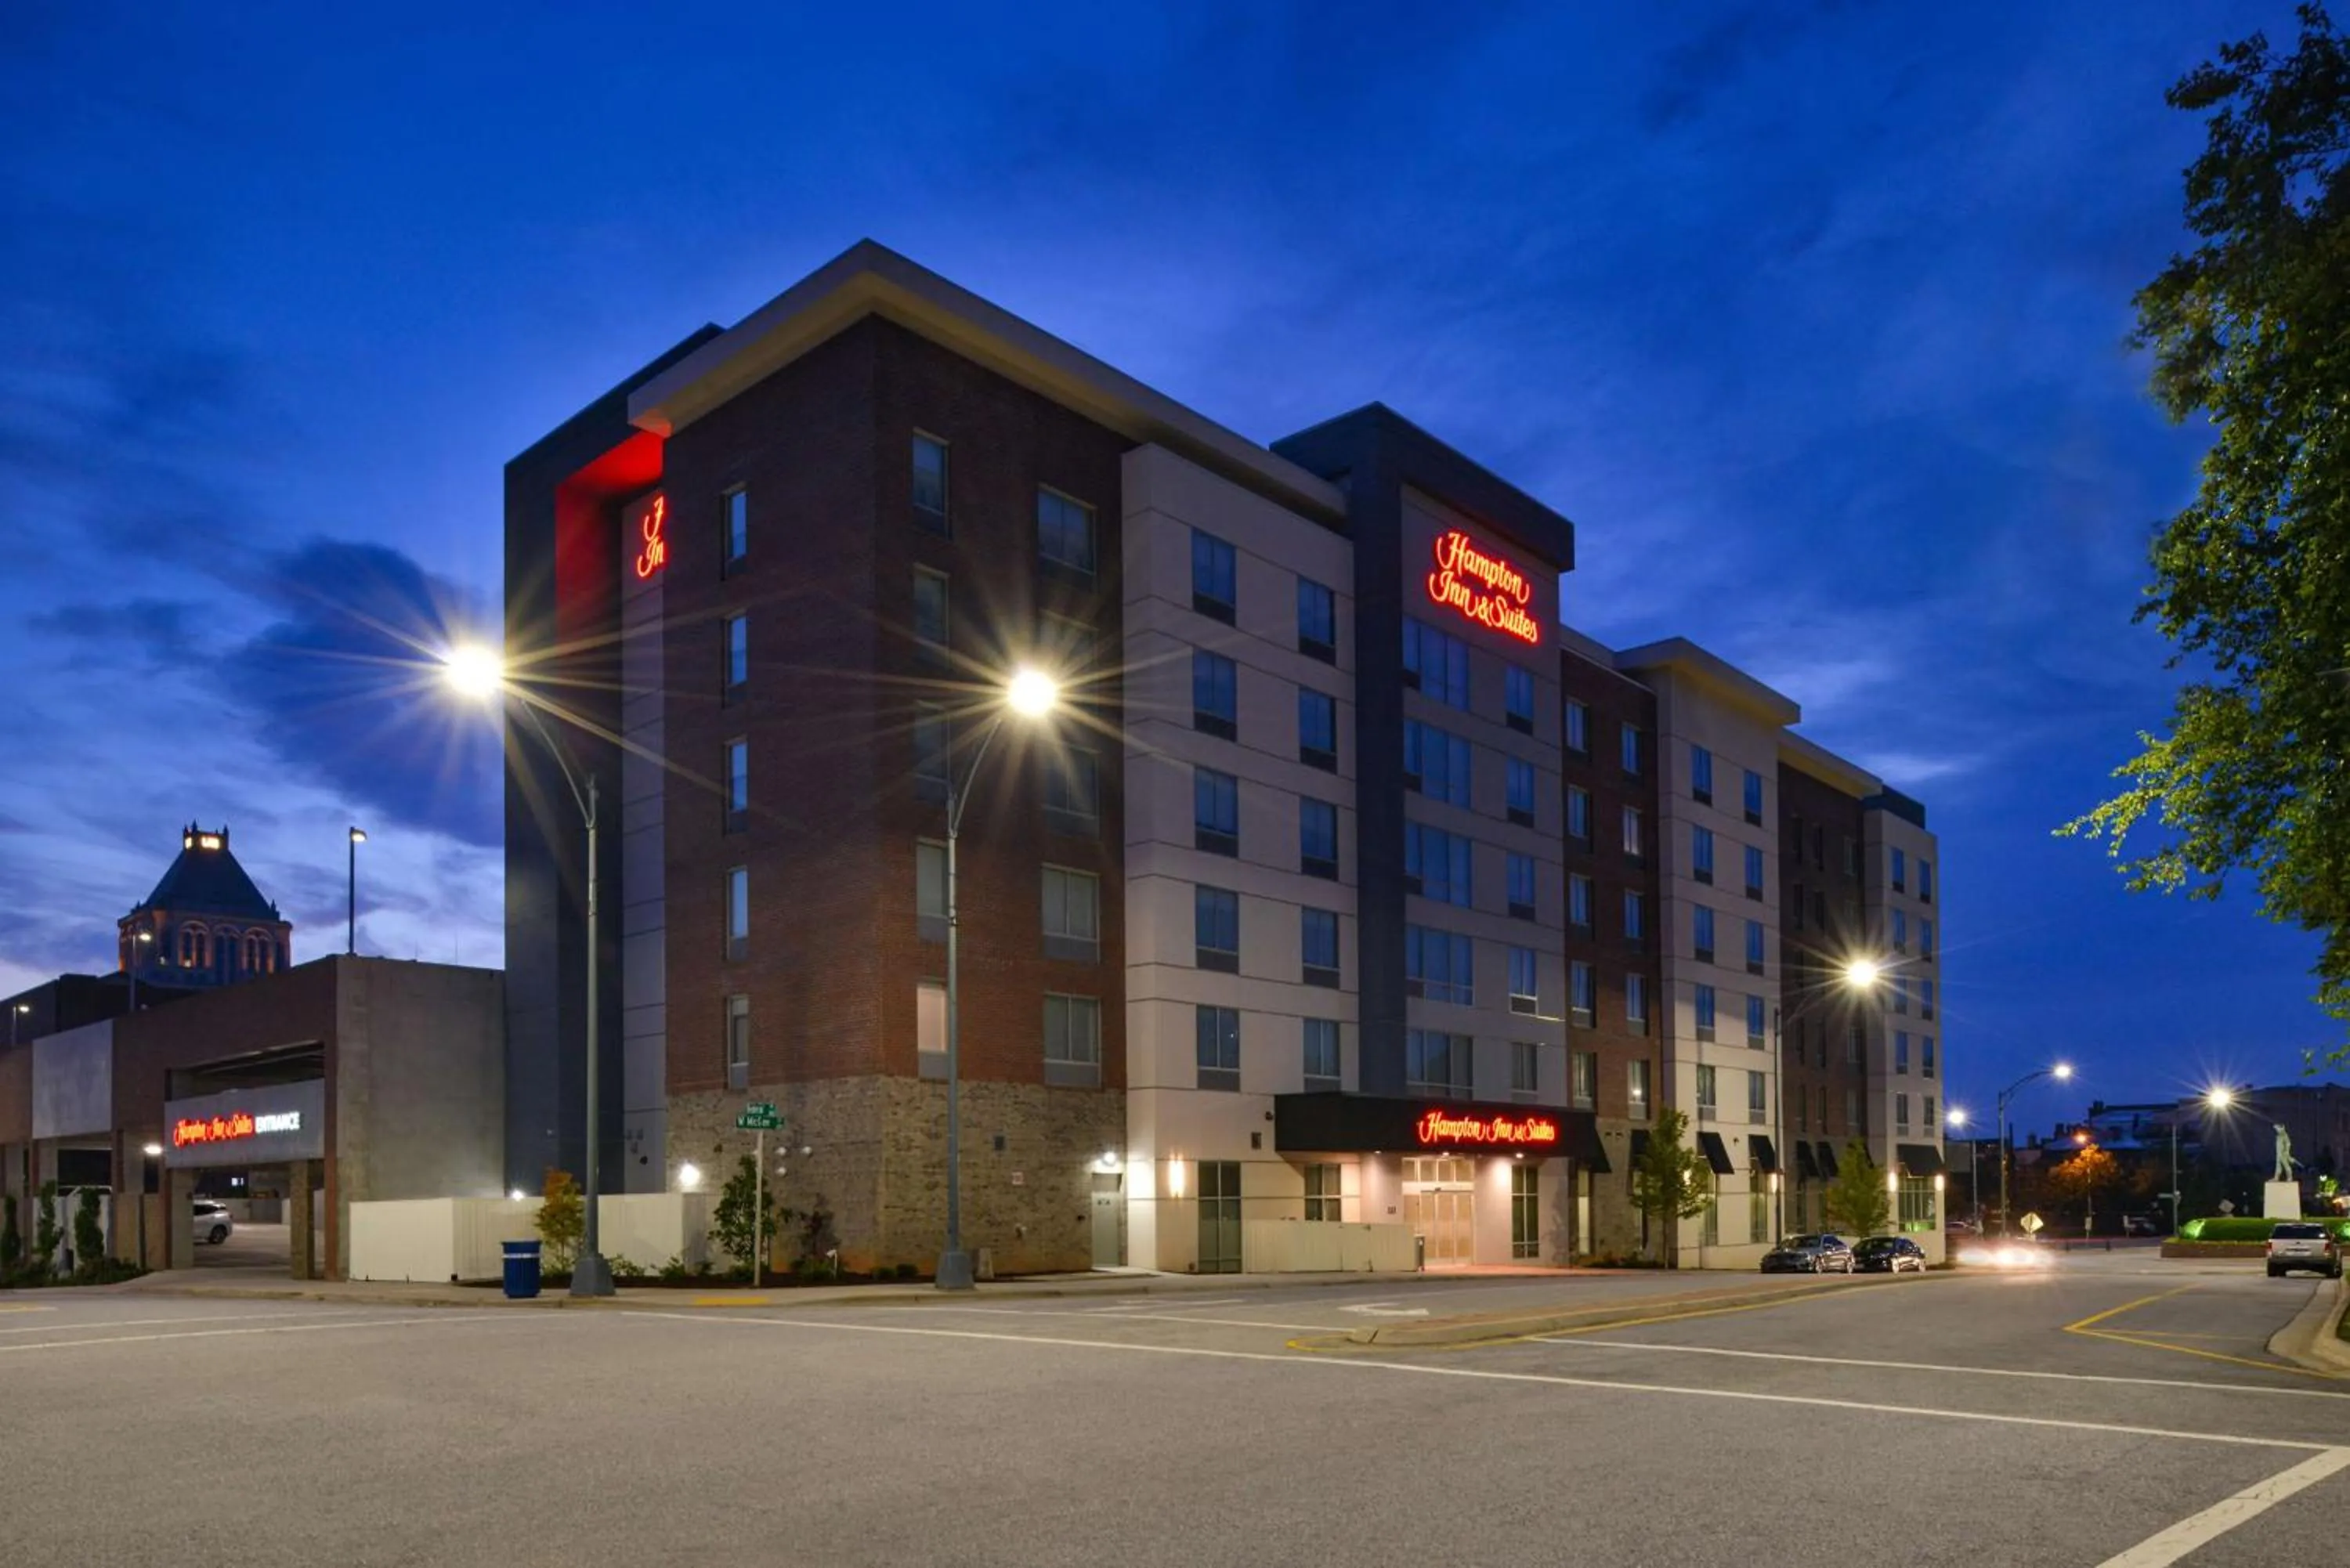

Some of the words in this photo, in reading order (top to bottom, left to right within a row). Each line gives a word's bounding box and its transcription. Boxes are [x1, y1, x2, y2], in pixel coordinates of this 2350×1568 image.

[637, 536, 664, 577] In
[1437, 532, 1530, 604] Hampton
[1429, 570, 1479, 617] Inn
[1477, 596, 1492, 627] &
[1489, 595, 1538, 642] Suites
[173, 1119, 208, 1147] Hampton
[255, 1111, 300, 1134] ENTRANCE
[1419, 1111, 1486, 1143] Hampton
[1488, 1117, 1516, 1142] Inn
[1515, 1124, 1525, 1142] &
[1524, 1118, 1555, 1141] Suites
